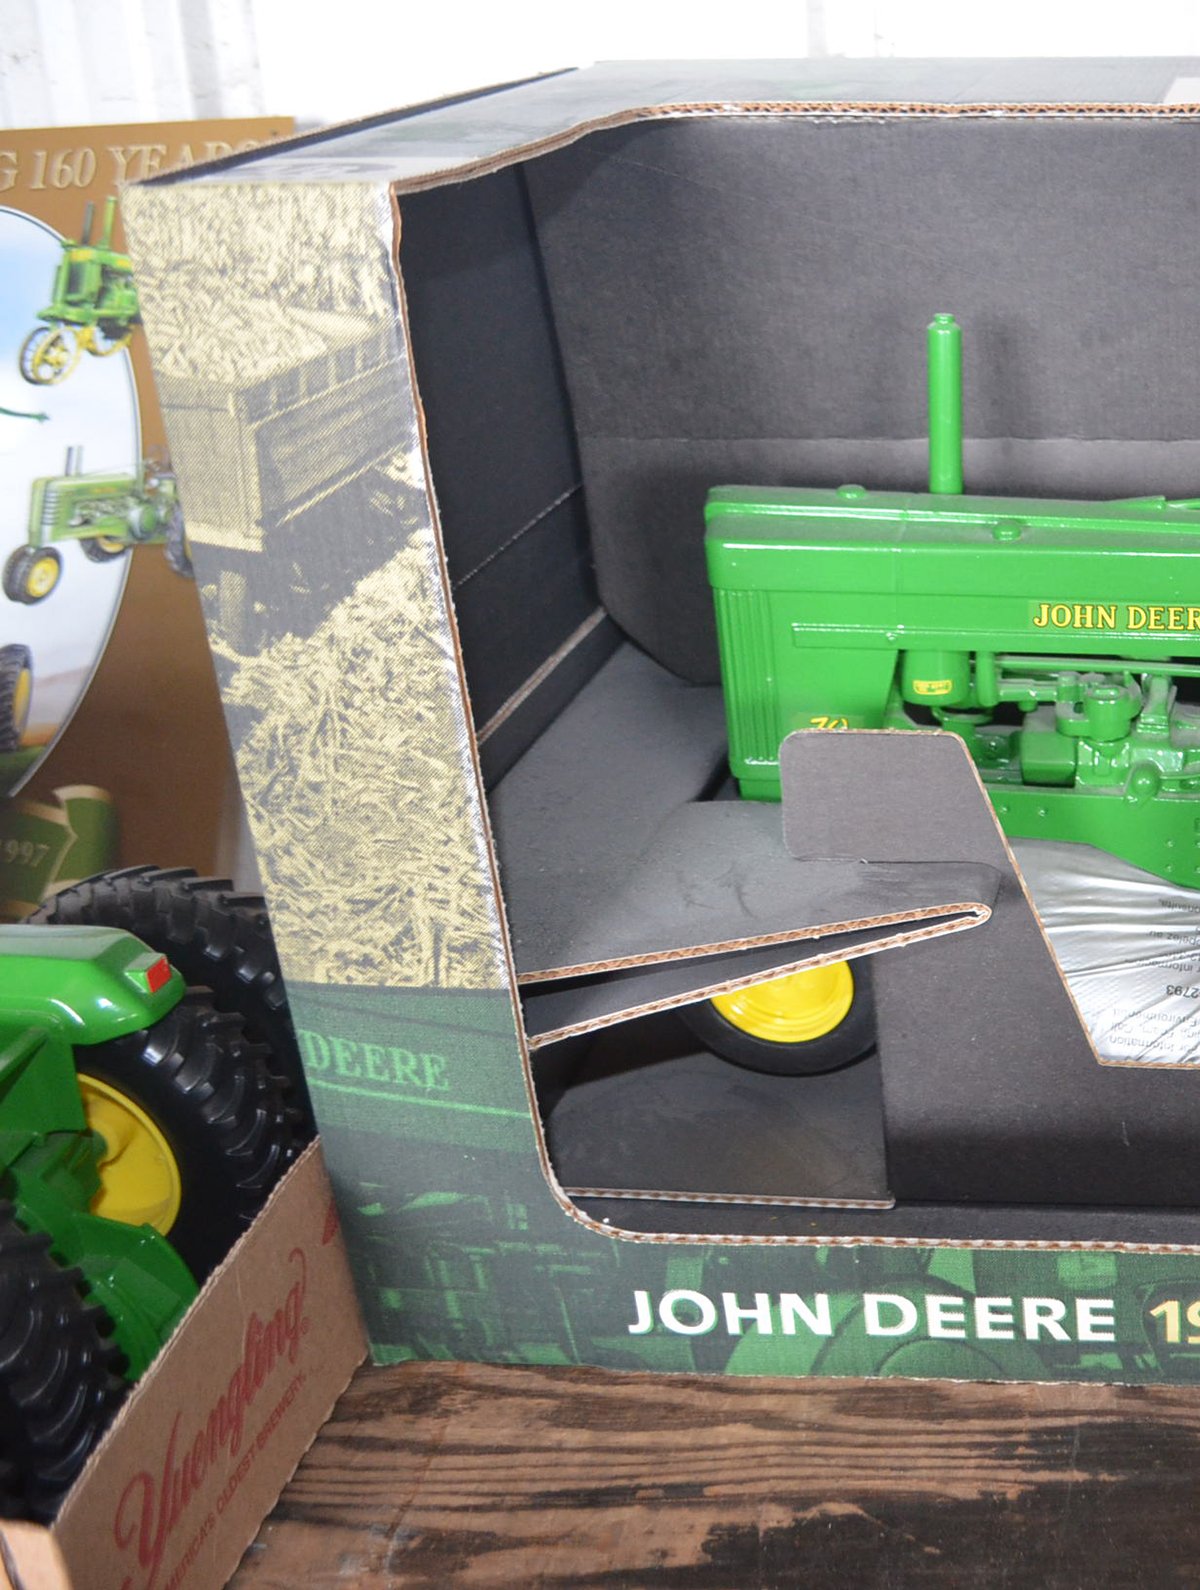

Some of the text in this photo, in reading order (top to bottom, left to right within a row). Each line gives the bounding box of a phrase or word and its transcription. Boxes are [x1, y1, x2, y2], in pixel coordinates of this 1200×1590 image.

[30, 147, 97, 190] 160
[1033, 603, 1118, 630] JOHN
[299, 1029, 449, 1090] DEERE
[628, 1289, 835, 1336] JOHN
[863, 1293, 1116, 1342] DEERE
